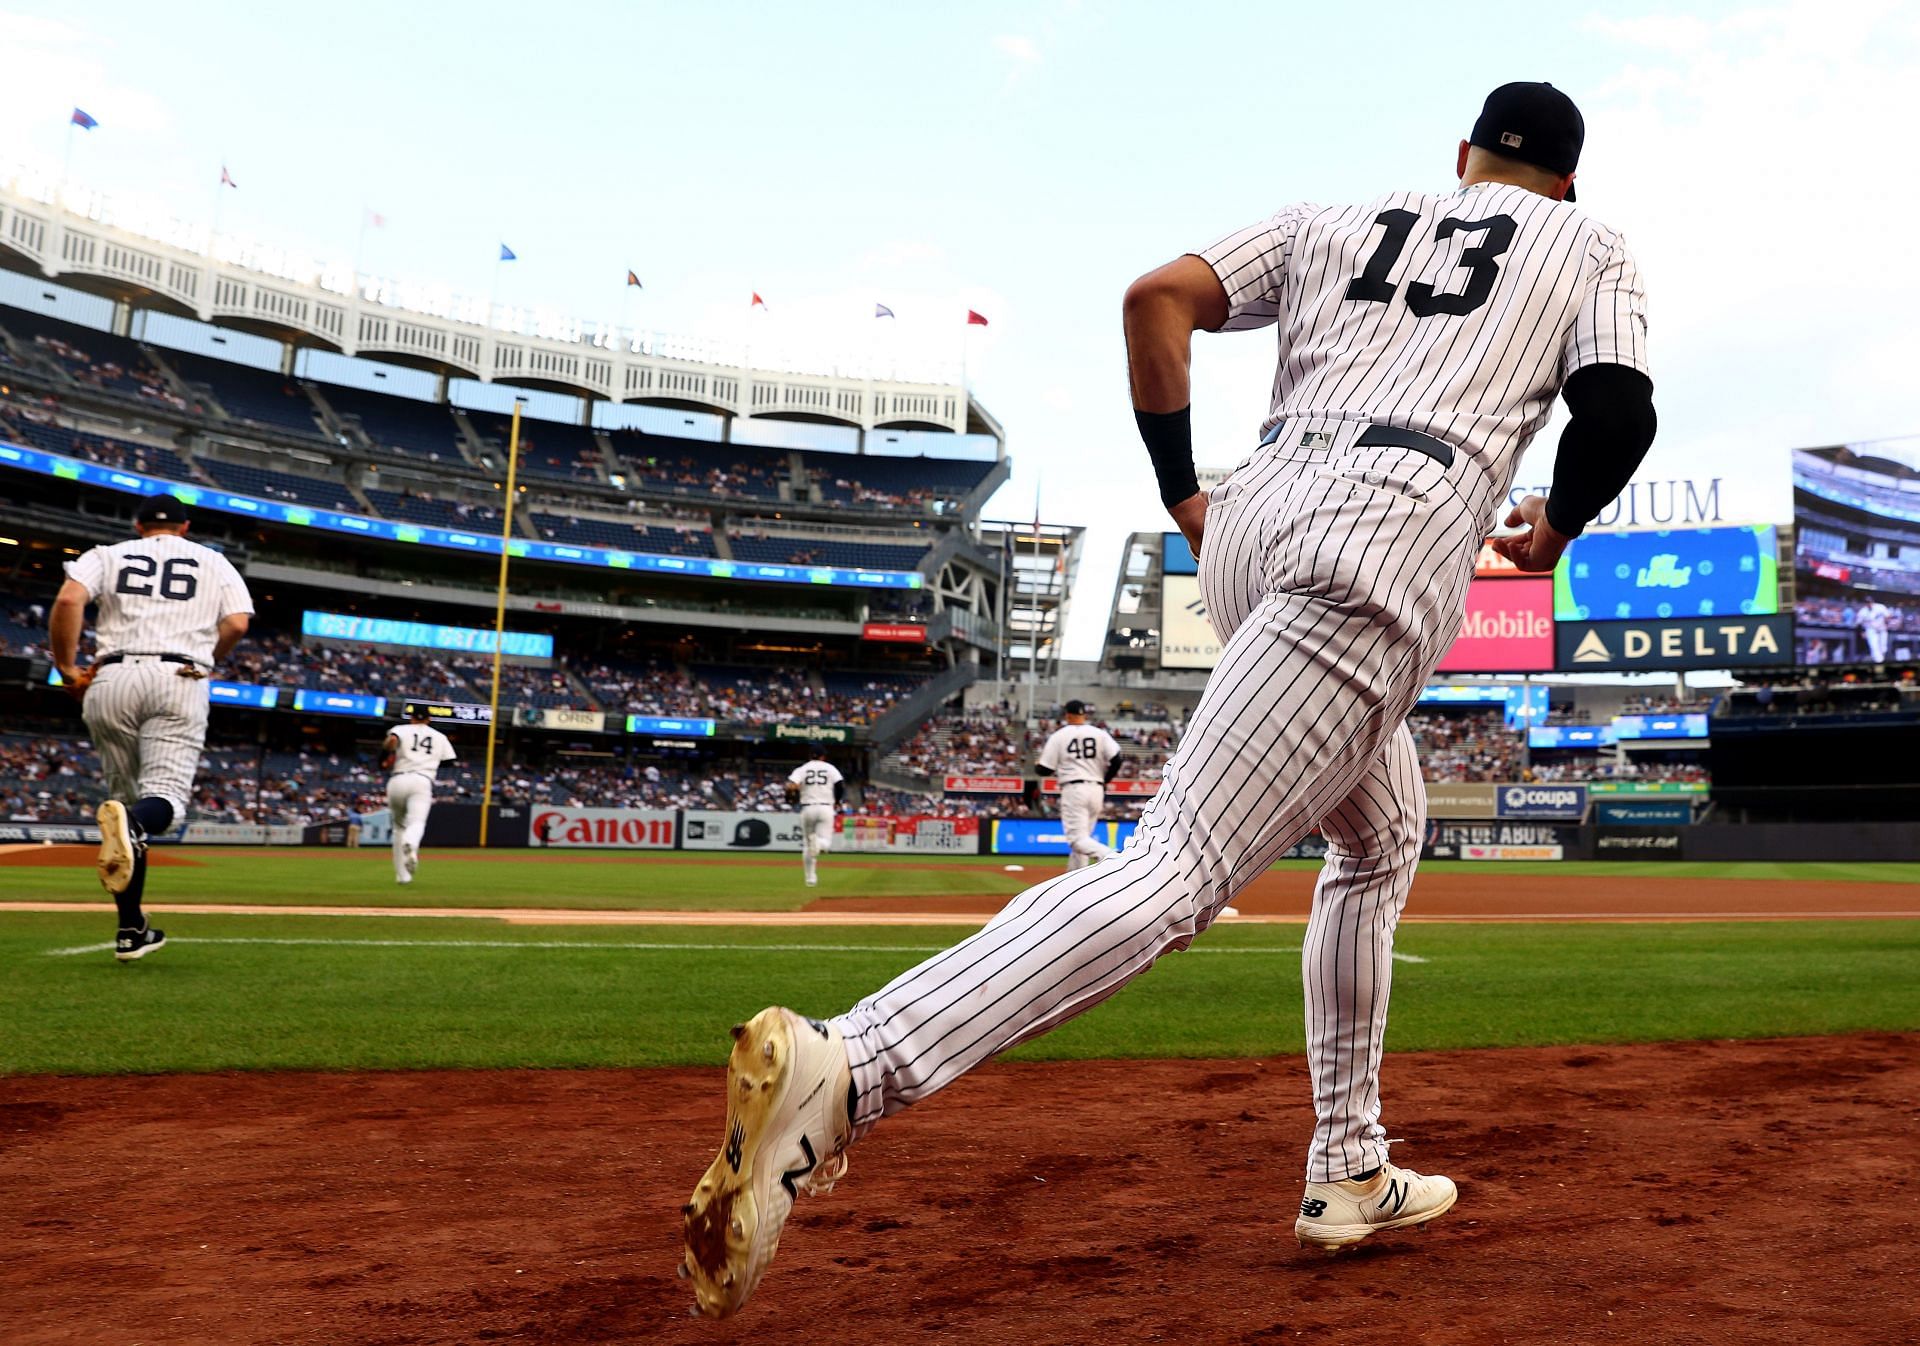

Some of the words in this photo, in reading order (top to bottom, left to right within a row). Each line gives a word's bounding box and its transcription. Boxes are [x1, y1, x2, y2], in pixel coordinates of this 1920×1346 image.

[1344, 208, 1517, 317] 13
[116, 554, 199, 600] 26
[1457, 608, 1551, 639] Mobile
[1625, 624, 1779, 660] DELTA
[410, 733, 433, 755] 14
[1066, 737, 1096, 759] 48
[805, 769, 828, 785] 25
[1526, 790, 1577, 808] coupa
[531, 811, 672, 846] Canon
